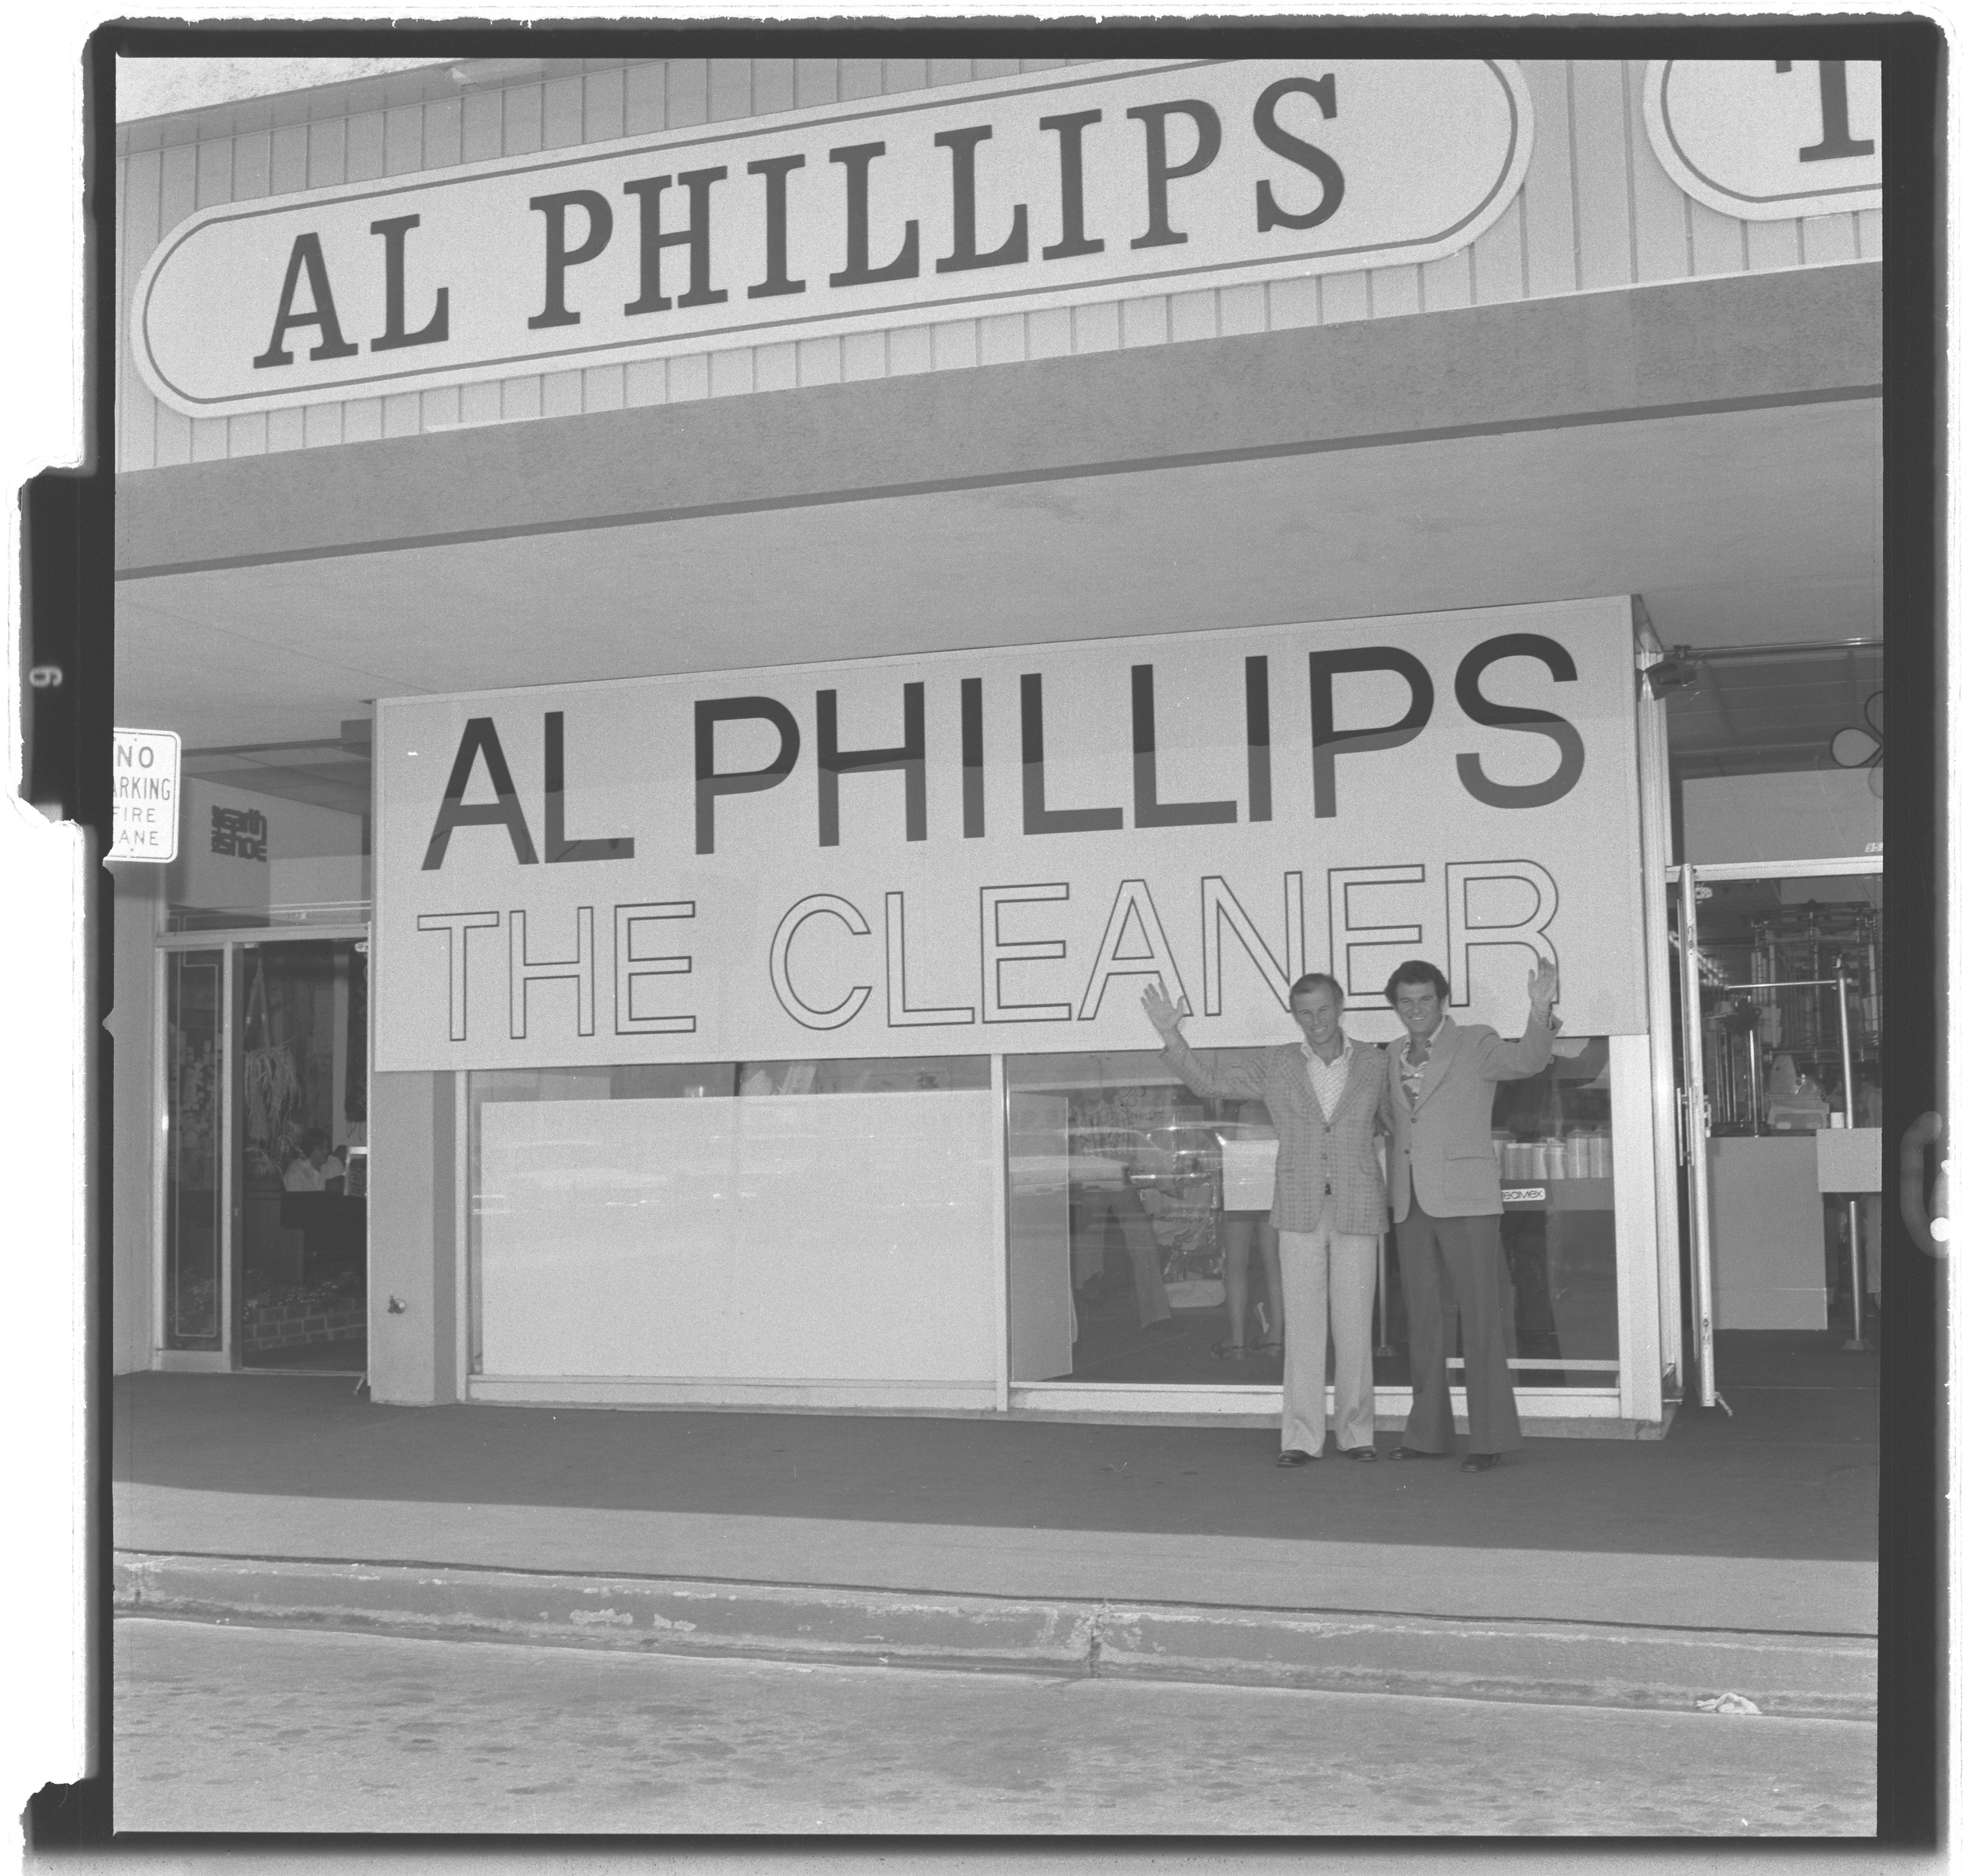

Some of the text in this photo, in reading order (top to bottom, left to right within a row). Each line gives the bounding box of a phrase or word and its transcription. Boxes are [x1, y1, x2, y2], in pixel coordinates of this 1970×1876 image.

[253, 73, 1346, 368] AL PHILLIPS
[113, 829, 159, 846] ANE
[116, 744, 155, 769] NO
[422, 632, 1585, 870] AL PHILLIPS
[417, 858, 1560, 1042] THE CLEANER
